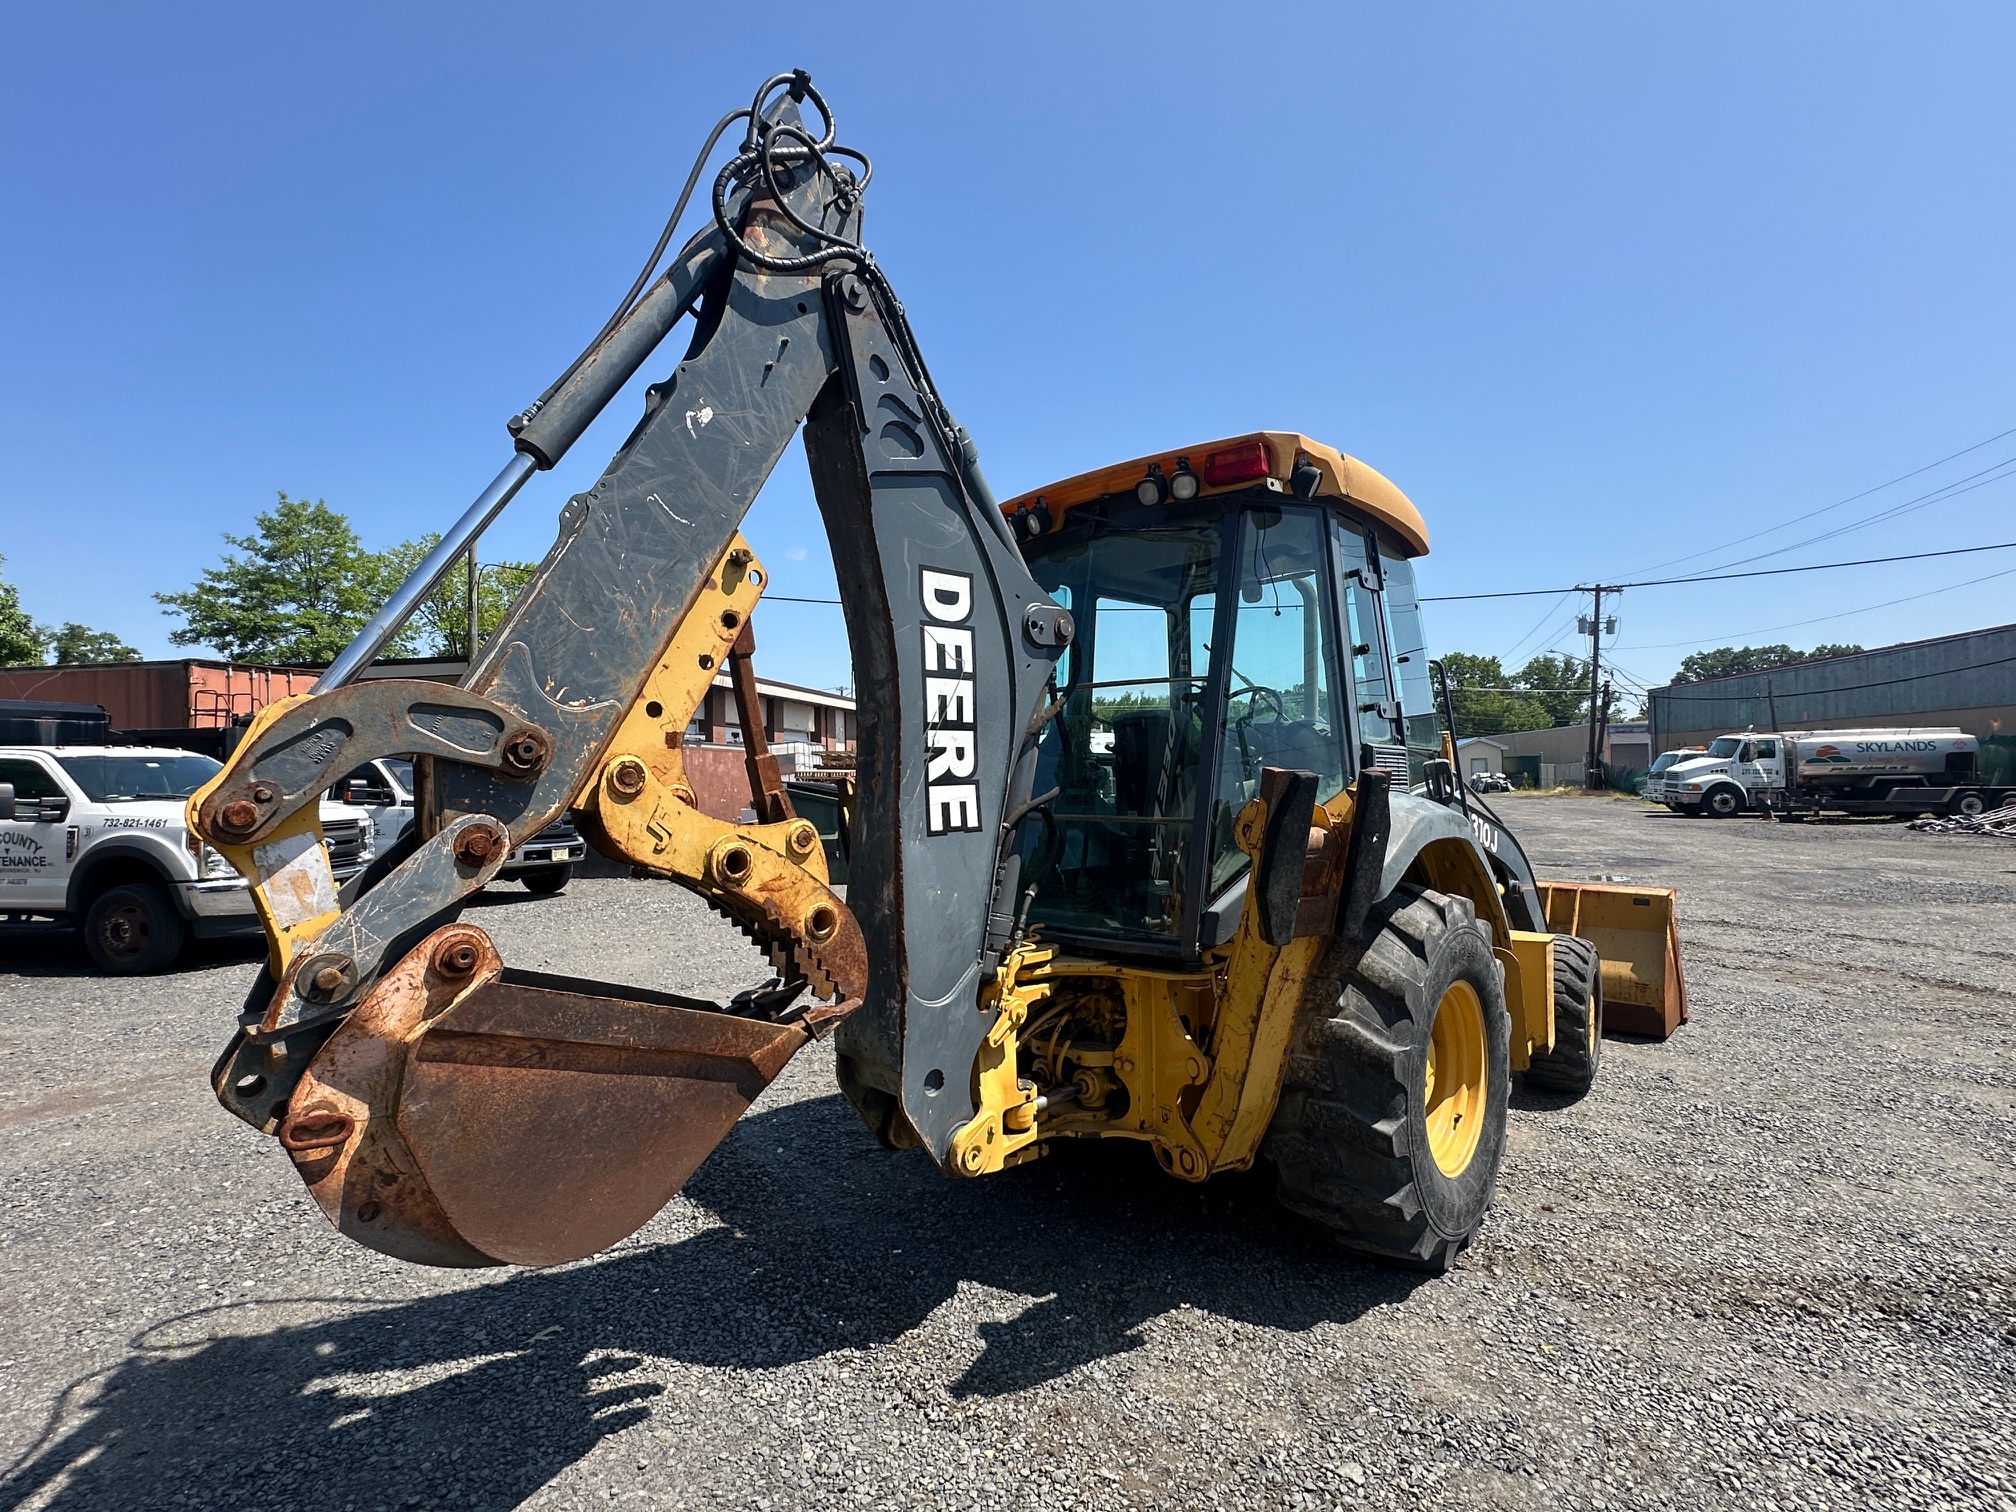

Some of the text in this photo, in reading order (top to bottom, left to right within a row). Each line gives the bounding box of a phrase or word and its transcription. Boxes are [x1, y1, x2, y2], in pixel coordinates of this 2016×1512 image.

[921, 568, 980, 833] DEERE
[1857, 741, 1936, 753] SKYLANDS
[1862, 764, 1887, 772] depend
[103, 818, 168, 828] 732-821-1461
[1471, 813, 1498, 853] 310J
[0, 832, 43, 855] OUNTY
